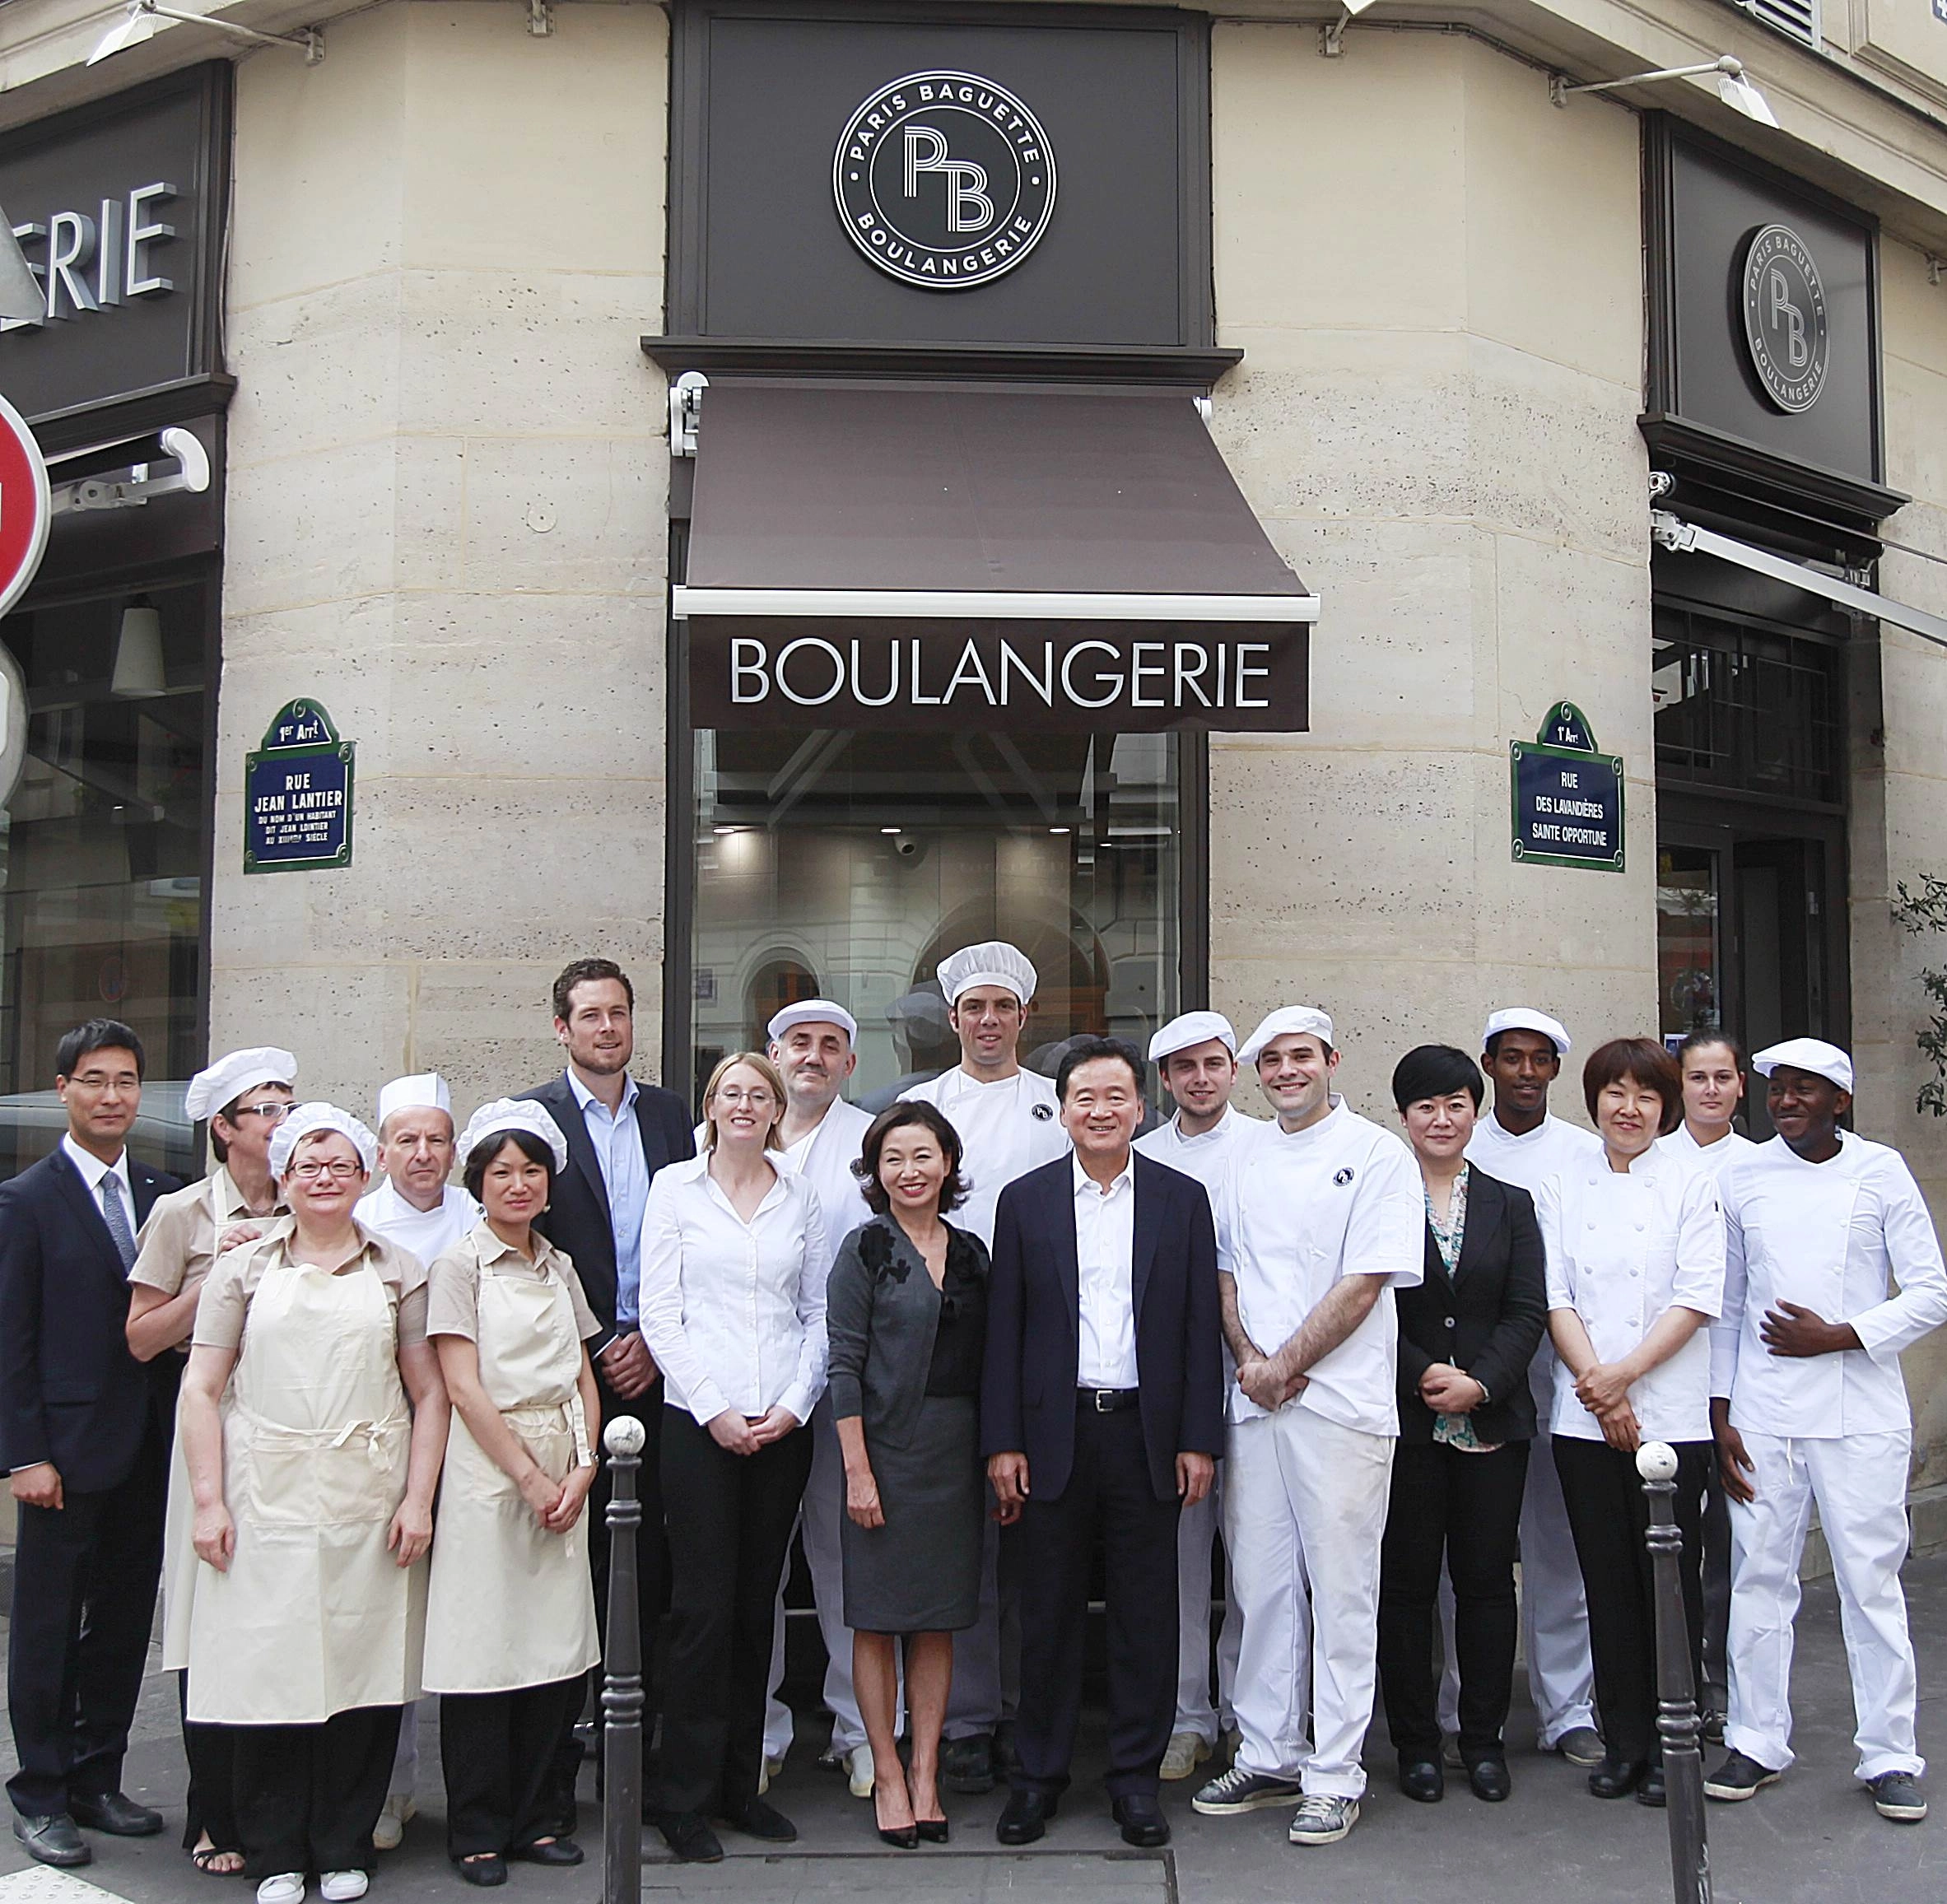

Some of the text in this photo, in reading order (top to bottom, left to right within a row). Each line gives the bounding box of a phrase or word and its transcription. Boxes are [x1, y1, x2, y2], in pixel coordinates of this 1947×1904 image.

[850, 83, 1040, 163] PARIS BAGUETTE
[904, 125, 994, 232] PB
[857, 212, 1032, 275] BOULANGERIE
[1750, 235, 1824, 316] PARIS BAGUETTE
[1754, 338, 1823, 401] BOULANGERIE
[730, 637, 1270, 709] BOULANGERIE
[286, 773, 310, 791] RUE
[1561, 771, 1578, 789] RUE
[254, 790, 342, 813] JEAN LANTIER
[1535, 795, 1604, 820] DES LAVANDIÈRES
[258, 816, 268, 824] DU
[269, 814, 285, 823] NOM
[279, 824, 297, 834] JEAN
[1532, 822, 1608, 847] SAINTE OPPORTUNE
